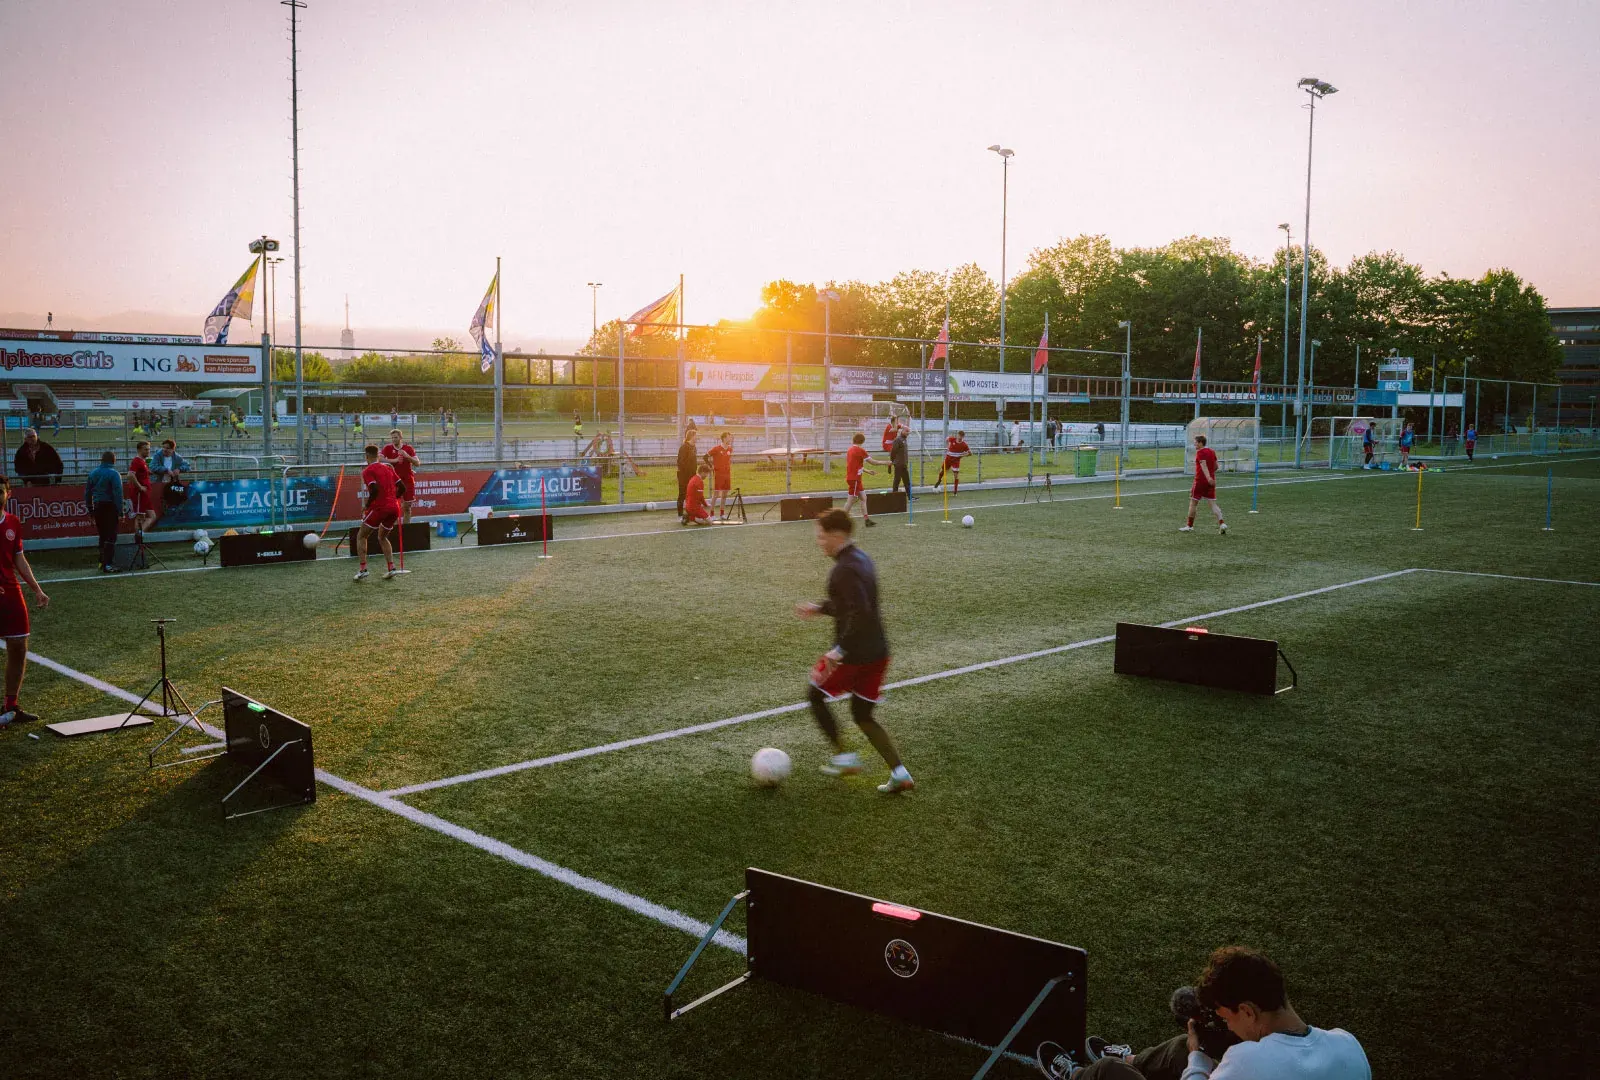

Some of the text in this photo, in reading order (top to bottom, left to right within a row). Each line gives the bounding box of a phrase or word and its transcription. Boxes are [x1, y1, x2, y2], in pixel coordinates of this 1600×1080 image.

[132, 357, 172, 372] ING
[962, 379, 976, 387] VMD
[977, 380, 999, 389] KOSTER
[501, 477, 582, 501] F LEAGUE
[200, 489, 309, 517] F LEAGUE
